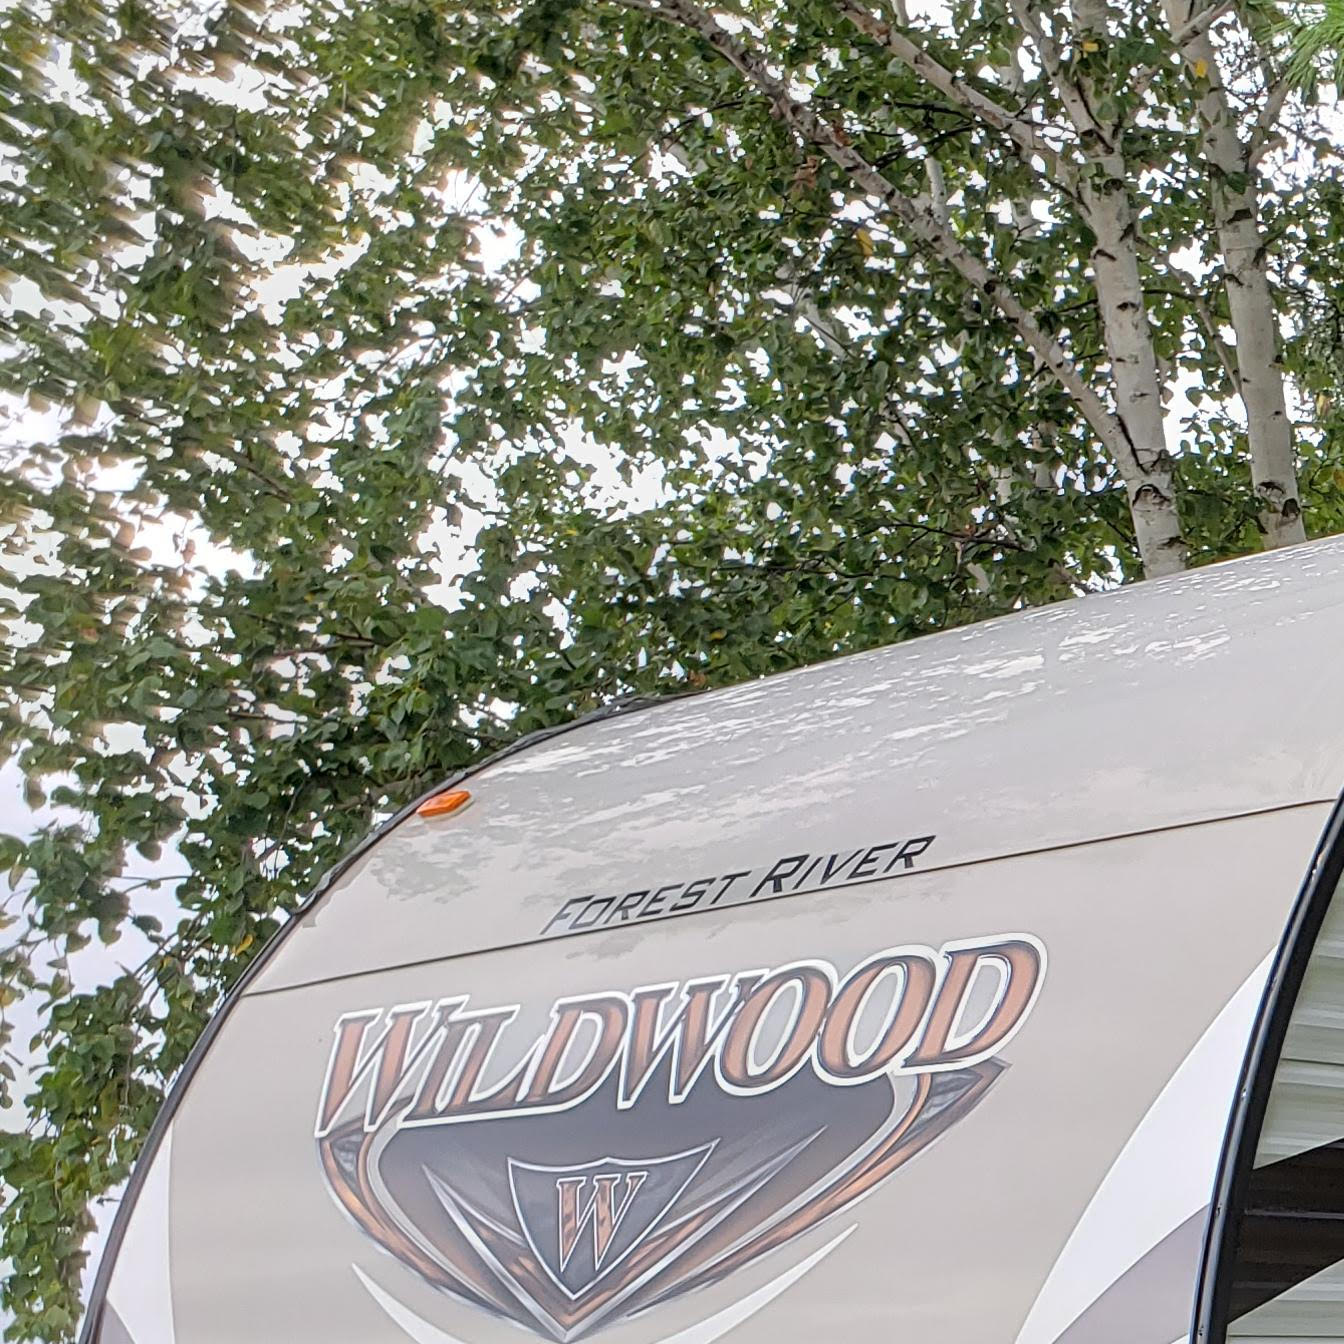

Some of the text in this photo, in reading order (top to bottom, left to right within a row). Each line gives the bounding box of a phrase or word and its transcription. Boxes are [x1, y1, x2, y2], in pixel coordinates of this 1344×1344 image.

[540, 835, 936, 935] FOREST RIVER
[317, 934, 1046, 1135] WILDWOOD
